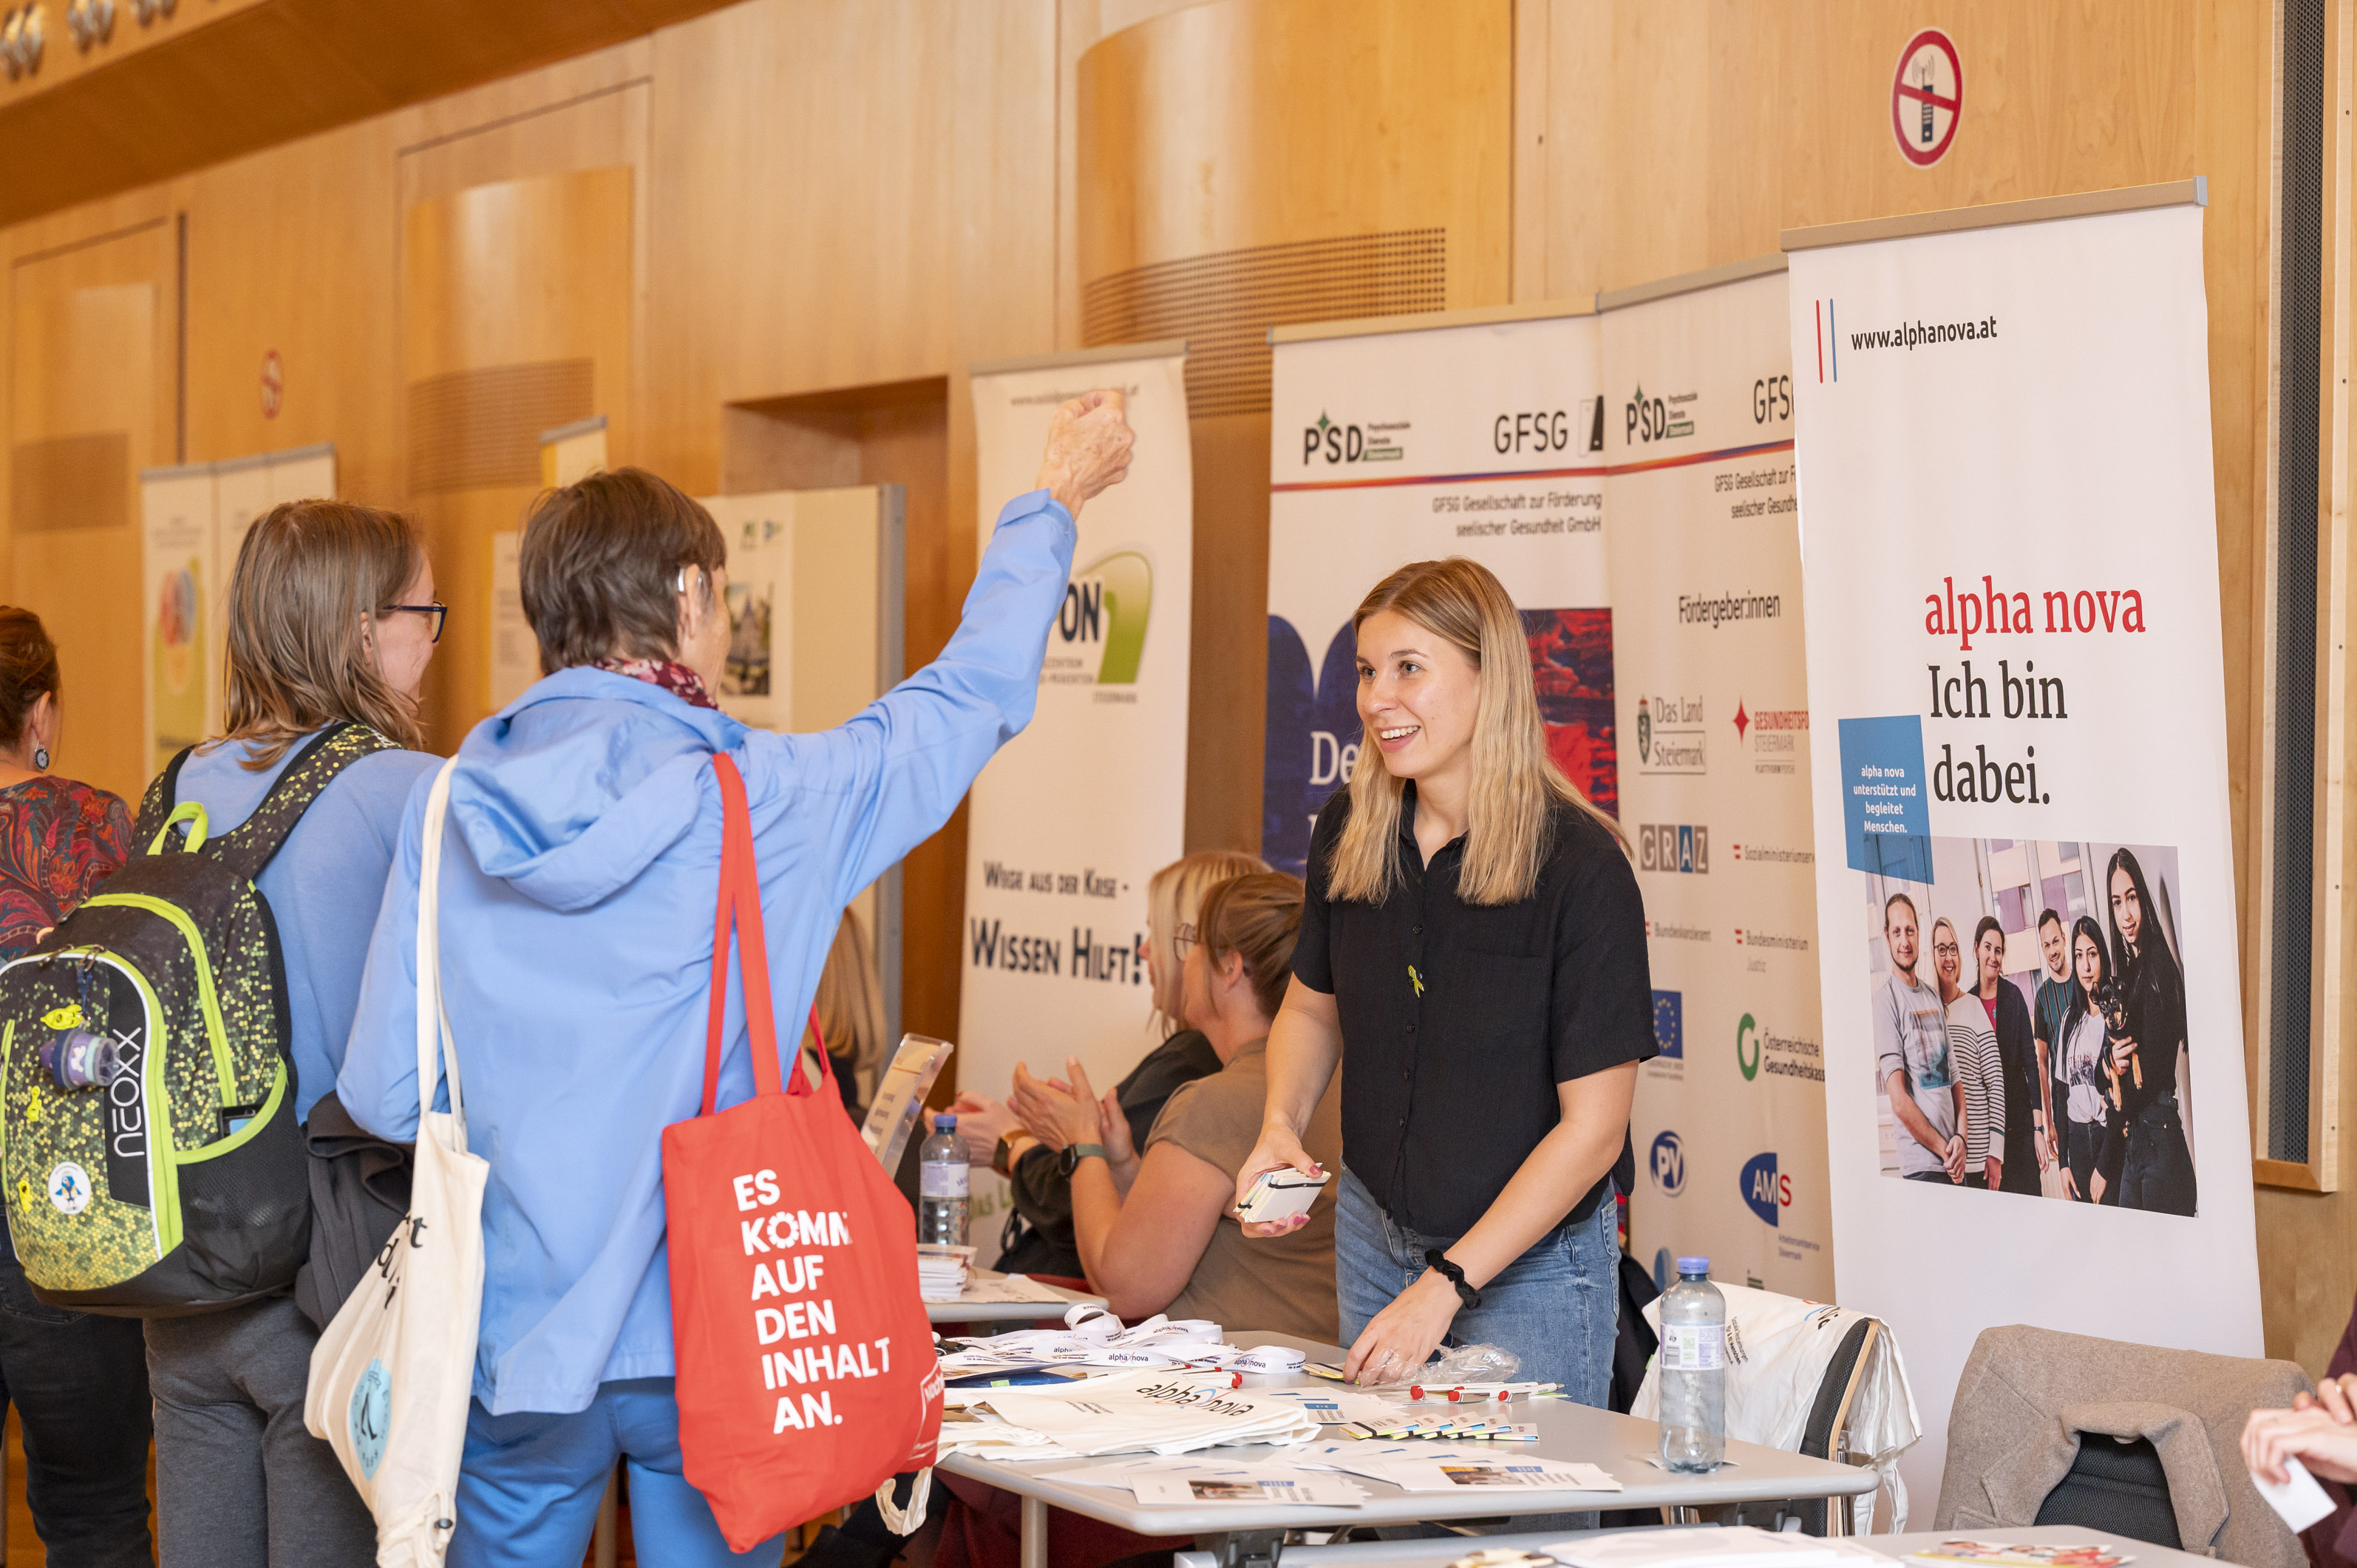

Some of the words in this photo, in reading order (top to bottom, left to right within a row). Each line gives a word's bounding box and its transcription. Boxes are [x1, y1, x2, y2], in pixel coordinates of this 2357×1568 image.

[1851, 316, 1998, 352] www.alphanova.at
[1754, 375, 1795, 424] GFS
[1494, 410, 1568, 454] GFSG
[1626, 398, 1666, 445] PSD
[1303, 424, 1363, 466] PSD
[1714, 474, 1733, 493] GFSG
[1735, 468, 1777, 490] Gesellschaft
[1778, 470, 1789, 485] zur
[1432, 496, 1461, 514] GFSG
[1463, 492, 1527, 512] Gesellschaft
[1528, 495, 1545, 510] zur
[1548, 490, 1602, 512] Förderung
[1732, 500, 1766, 519] seelischer
[1767, 494, 1797, 514] Gesundhe
[1456, 520, 1507, 538] seelischer
[1510, 517, 1565, 536] Gesundheit
[1568, 515, 1602, 534] GmbH
[1679, 590, 1781, 629] Fördergeber:innen
[1925, 575, 2034, 652] alpha
[2044, 589, 2146, 634] nova
[1928, 659, 1991, 719] Ich
[1999, 659, 2068, 719] bin
[1654, 697, 1679, 724] Das
[1680, 695, 1704, 724] Land
[1754, 710, 1809, 731] GESUNDHEITSFO
[1653, 740, 1705, 768] Steiermark
[1861, 764, 1882, 780] alpha
[1884, 768, 1905, 778] nova
[1853, 783, 1899, 797] unterstützt
[1900, 783, 1916, 797] und
[1933, 743, 2050, 805] dabei.
[1865, 800, 1904, 817] begleitet
[1864, 820, 1908, 834] Menschen.
[1640, 827, 1708, 873] GRAZ
[1763, 1026, 1820, 1057] Österreichische
[1764, 1054, 1826, 1083] Gesundheitskass
[733, 1169, 780, 1212] ES
[1752, 1168, 1792, 1207] AMS
[741, 1210, 853, 1256] KOMM
[751, 1254, 825, 1301] AUF
[755, 1299, 837, 1346] DEN
[761, 1336, 891, 1391] INHALT
[1108, 1353, 1128, 1362] alpha
[1234, 1358, 1248, 1366] alpha
[773, 1391, 844, 1436] AN.
[1136, 1381, 1201, 1405] alpha
[1202, 1400, 1254, 1417] nova
